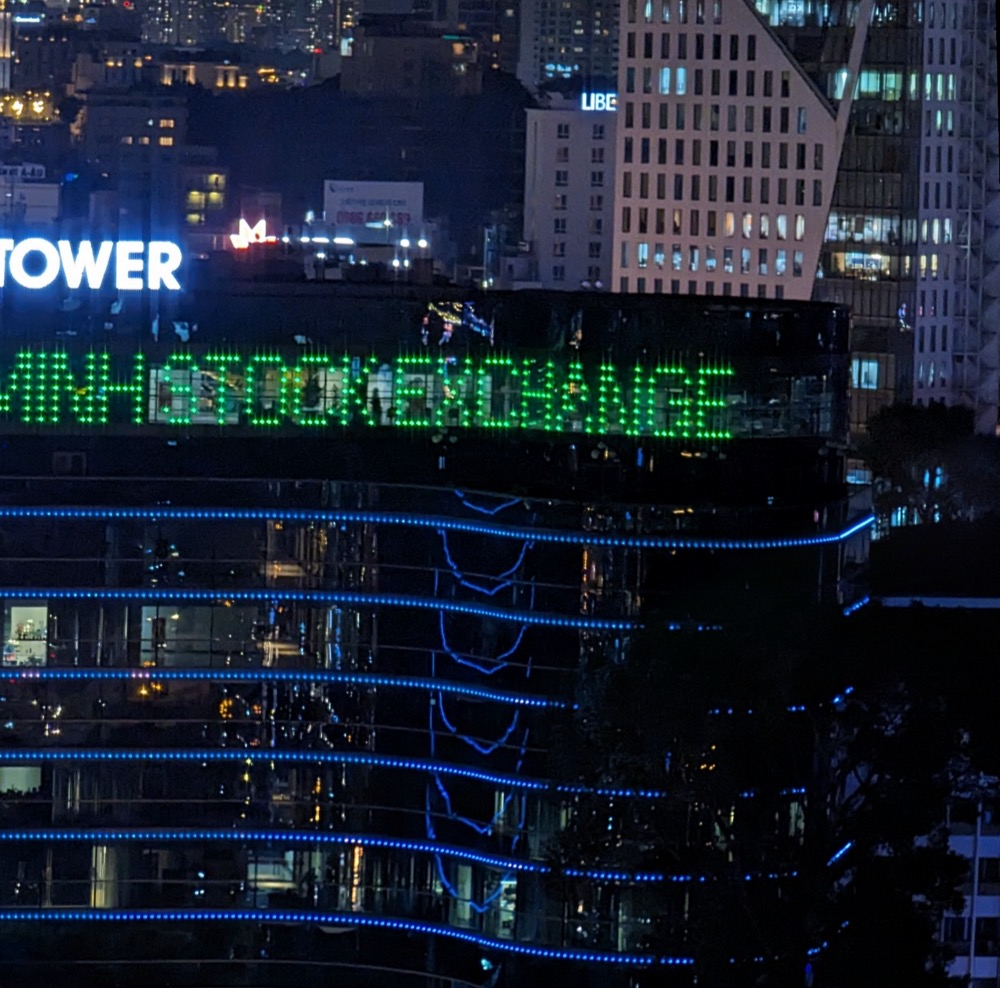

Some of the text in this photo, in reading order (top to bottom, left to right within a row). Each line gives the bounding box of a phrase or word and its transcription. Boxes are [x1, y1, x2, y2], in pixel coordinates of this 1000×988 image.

[581, 92, 616, 111] LIBE
[160, 351, 378, 427] STOCK
[394, 354, 736, 440] EXCHANGE
